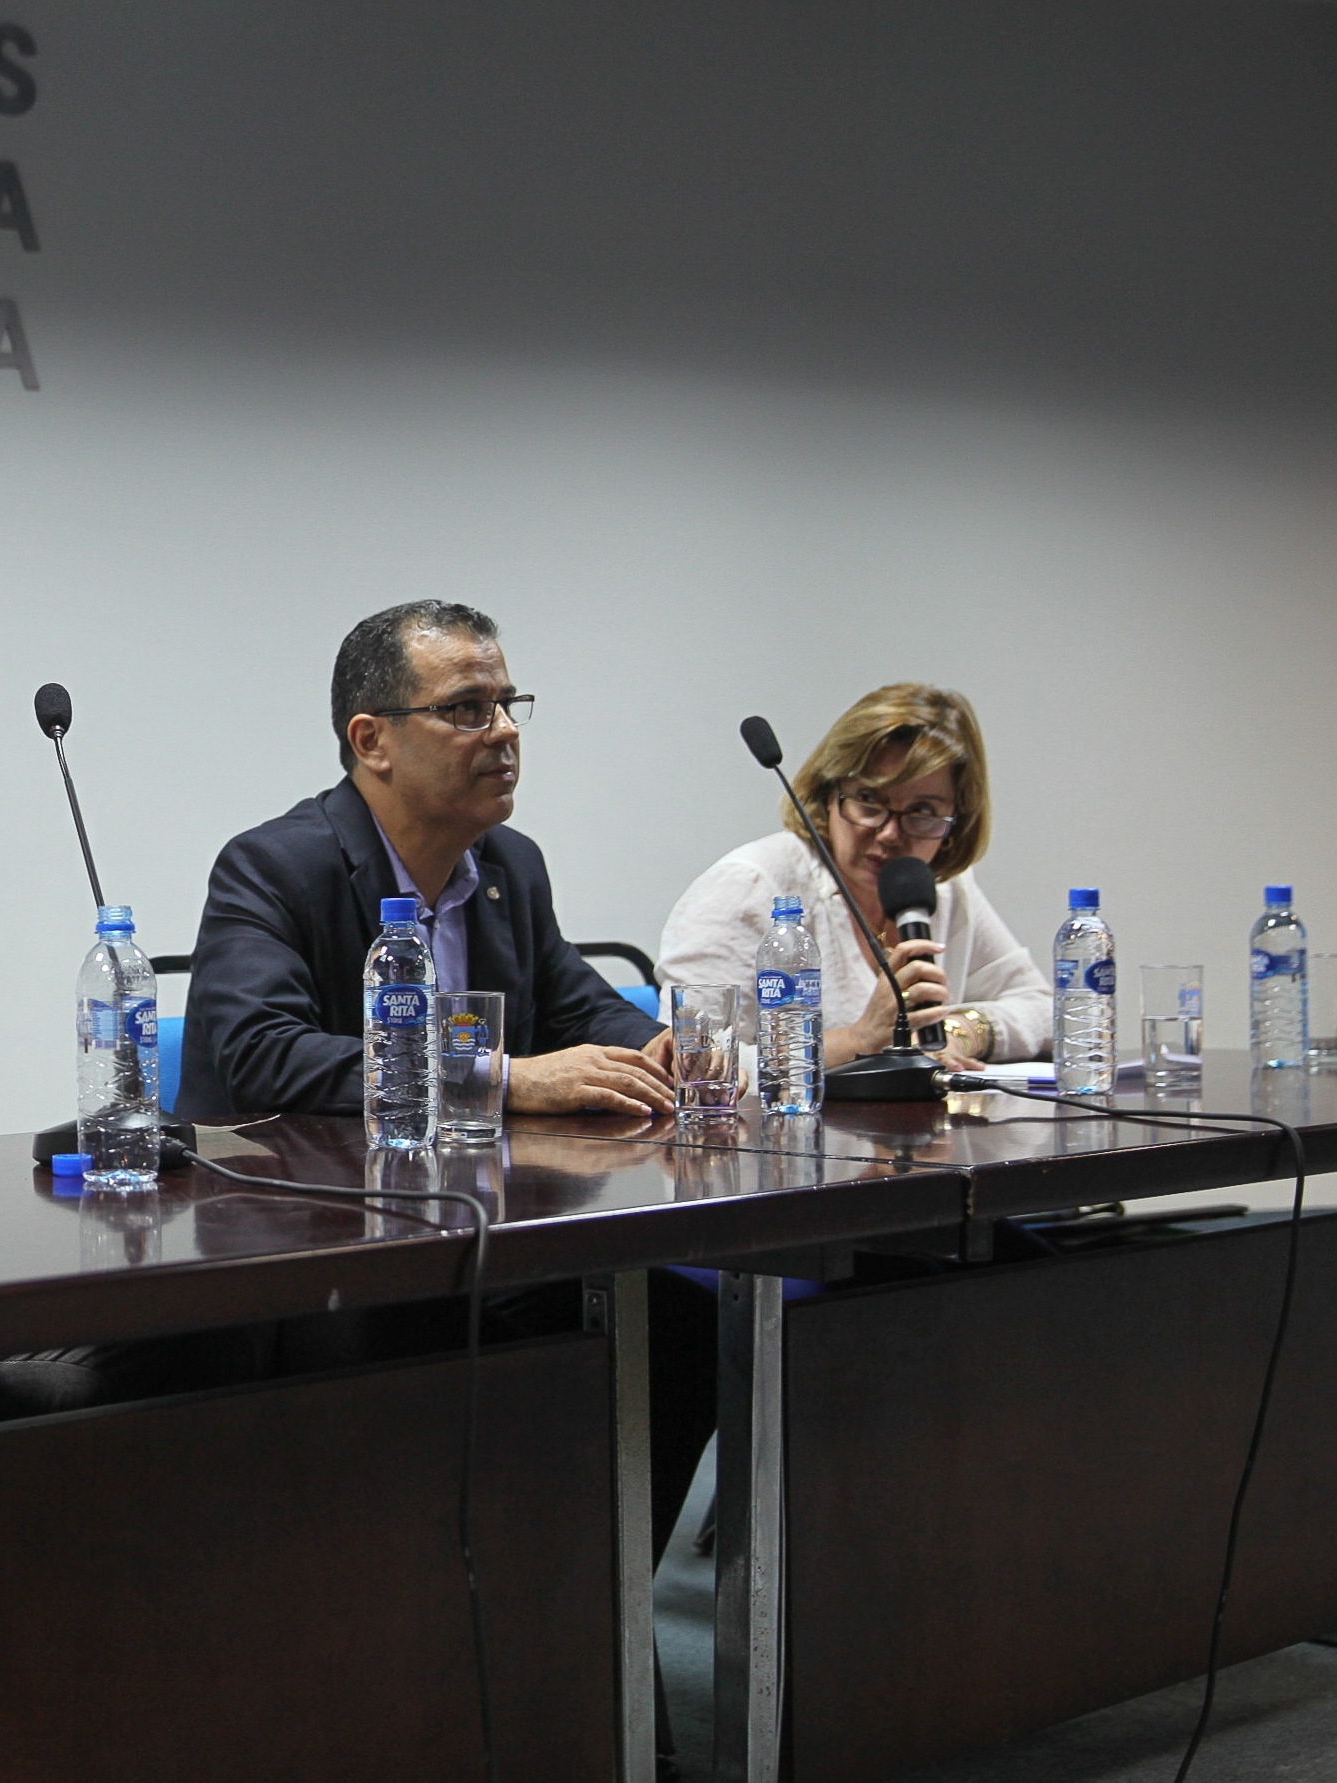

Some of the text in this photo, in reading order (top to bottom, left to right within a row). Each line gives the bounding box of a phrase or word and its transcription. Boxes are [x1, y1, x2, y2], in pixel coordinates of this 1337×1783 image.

[758, 978, 786, 989] SANTA
[761, 988, 782, 998] RITA
[382, 994, 420, 1006] SANTA
[390, 1005, 416, 1017] RITA
